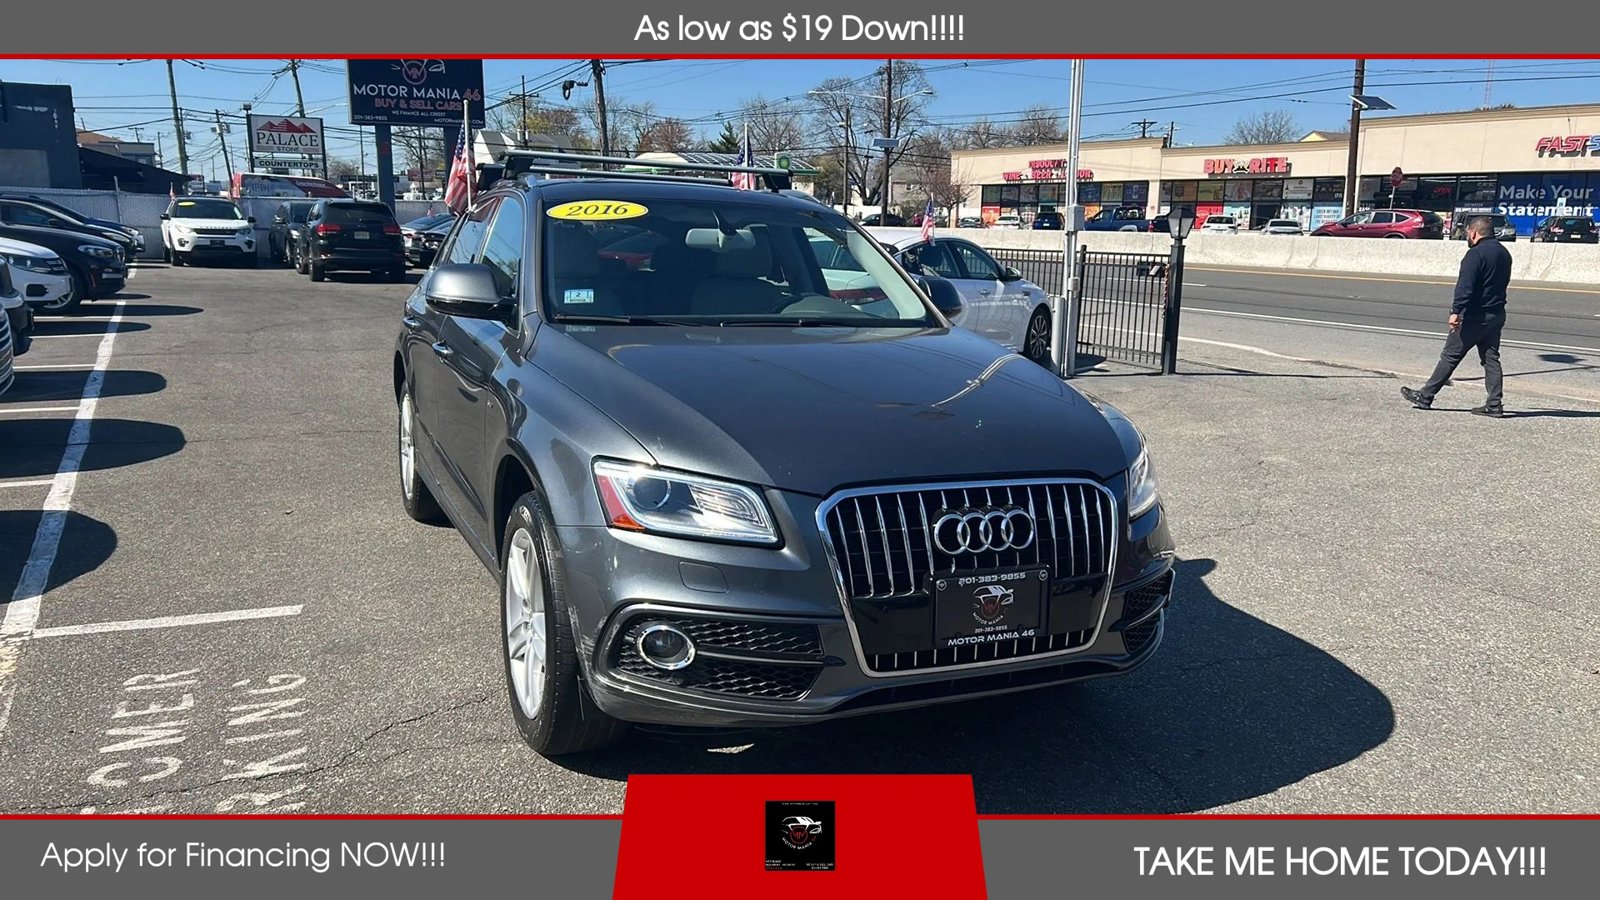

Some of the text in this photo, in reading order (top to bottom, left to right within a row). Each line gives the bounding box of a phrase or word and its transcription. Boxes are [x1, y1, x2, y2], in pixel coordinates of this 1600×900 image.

[353, 84, 481, 101] MOTOR MANIA 46
[375, 98, 463, 111] BUY & SELL CARS
[256, 132, 319, 147] PALACE
[259, 160, 319, 168] COUNTERTOPS
[1203, 157, 1288, 174] BUY RITE
[1002, 172, 1021, 180] WINE
[1032, 168, 1051, 180] BEER
[1433, 186, 1452, 194] OPEN
[1500, 184, 1594, 199] Make Your
[566, 204, 630, 217] 2016
[1498, 202, 1594, 216] Statement
[958, 572, 1026, 586] 201-383-9855
[972, 612, 987, 625] MOTOR
[948, 629, 1035, 646] MOTOR MANIA 46
